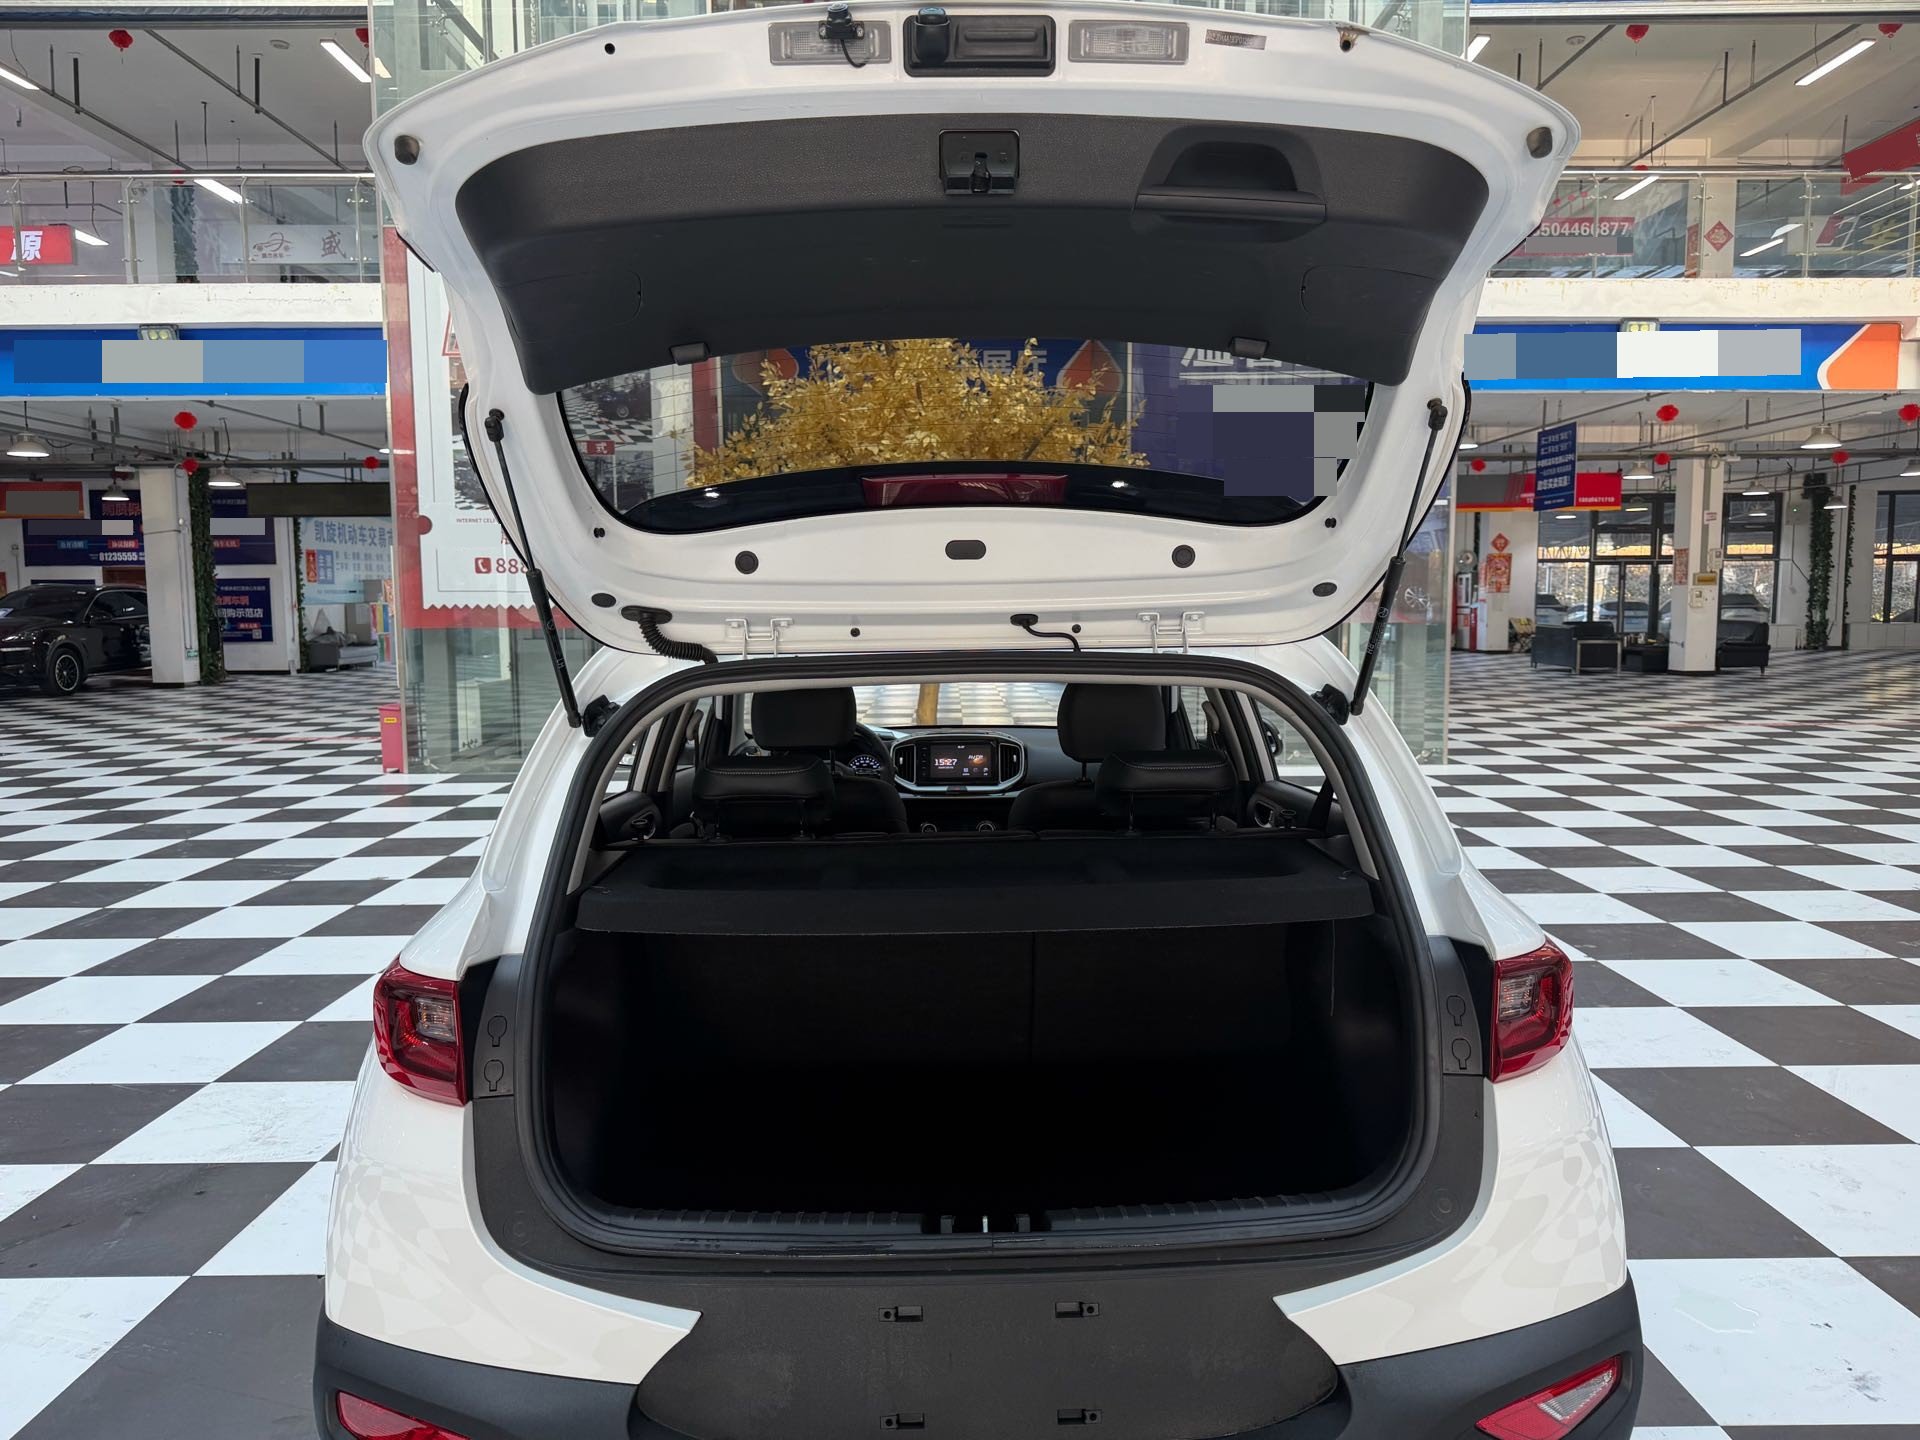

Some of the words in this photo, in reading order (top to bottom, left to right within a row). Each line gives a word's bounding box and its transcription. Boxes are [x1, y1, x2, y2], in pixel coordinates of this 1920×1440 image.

[11, 230, 43, 261] 源
[321, 229, 347, 259] 盛
[964, 349, 1048, 381] 展厅
[935, 758, 958, 766] 15:27
